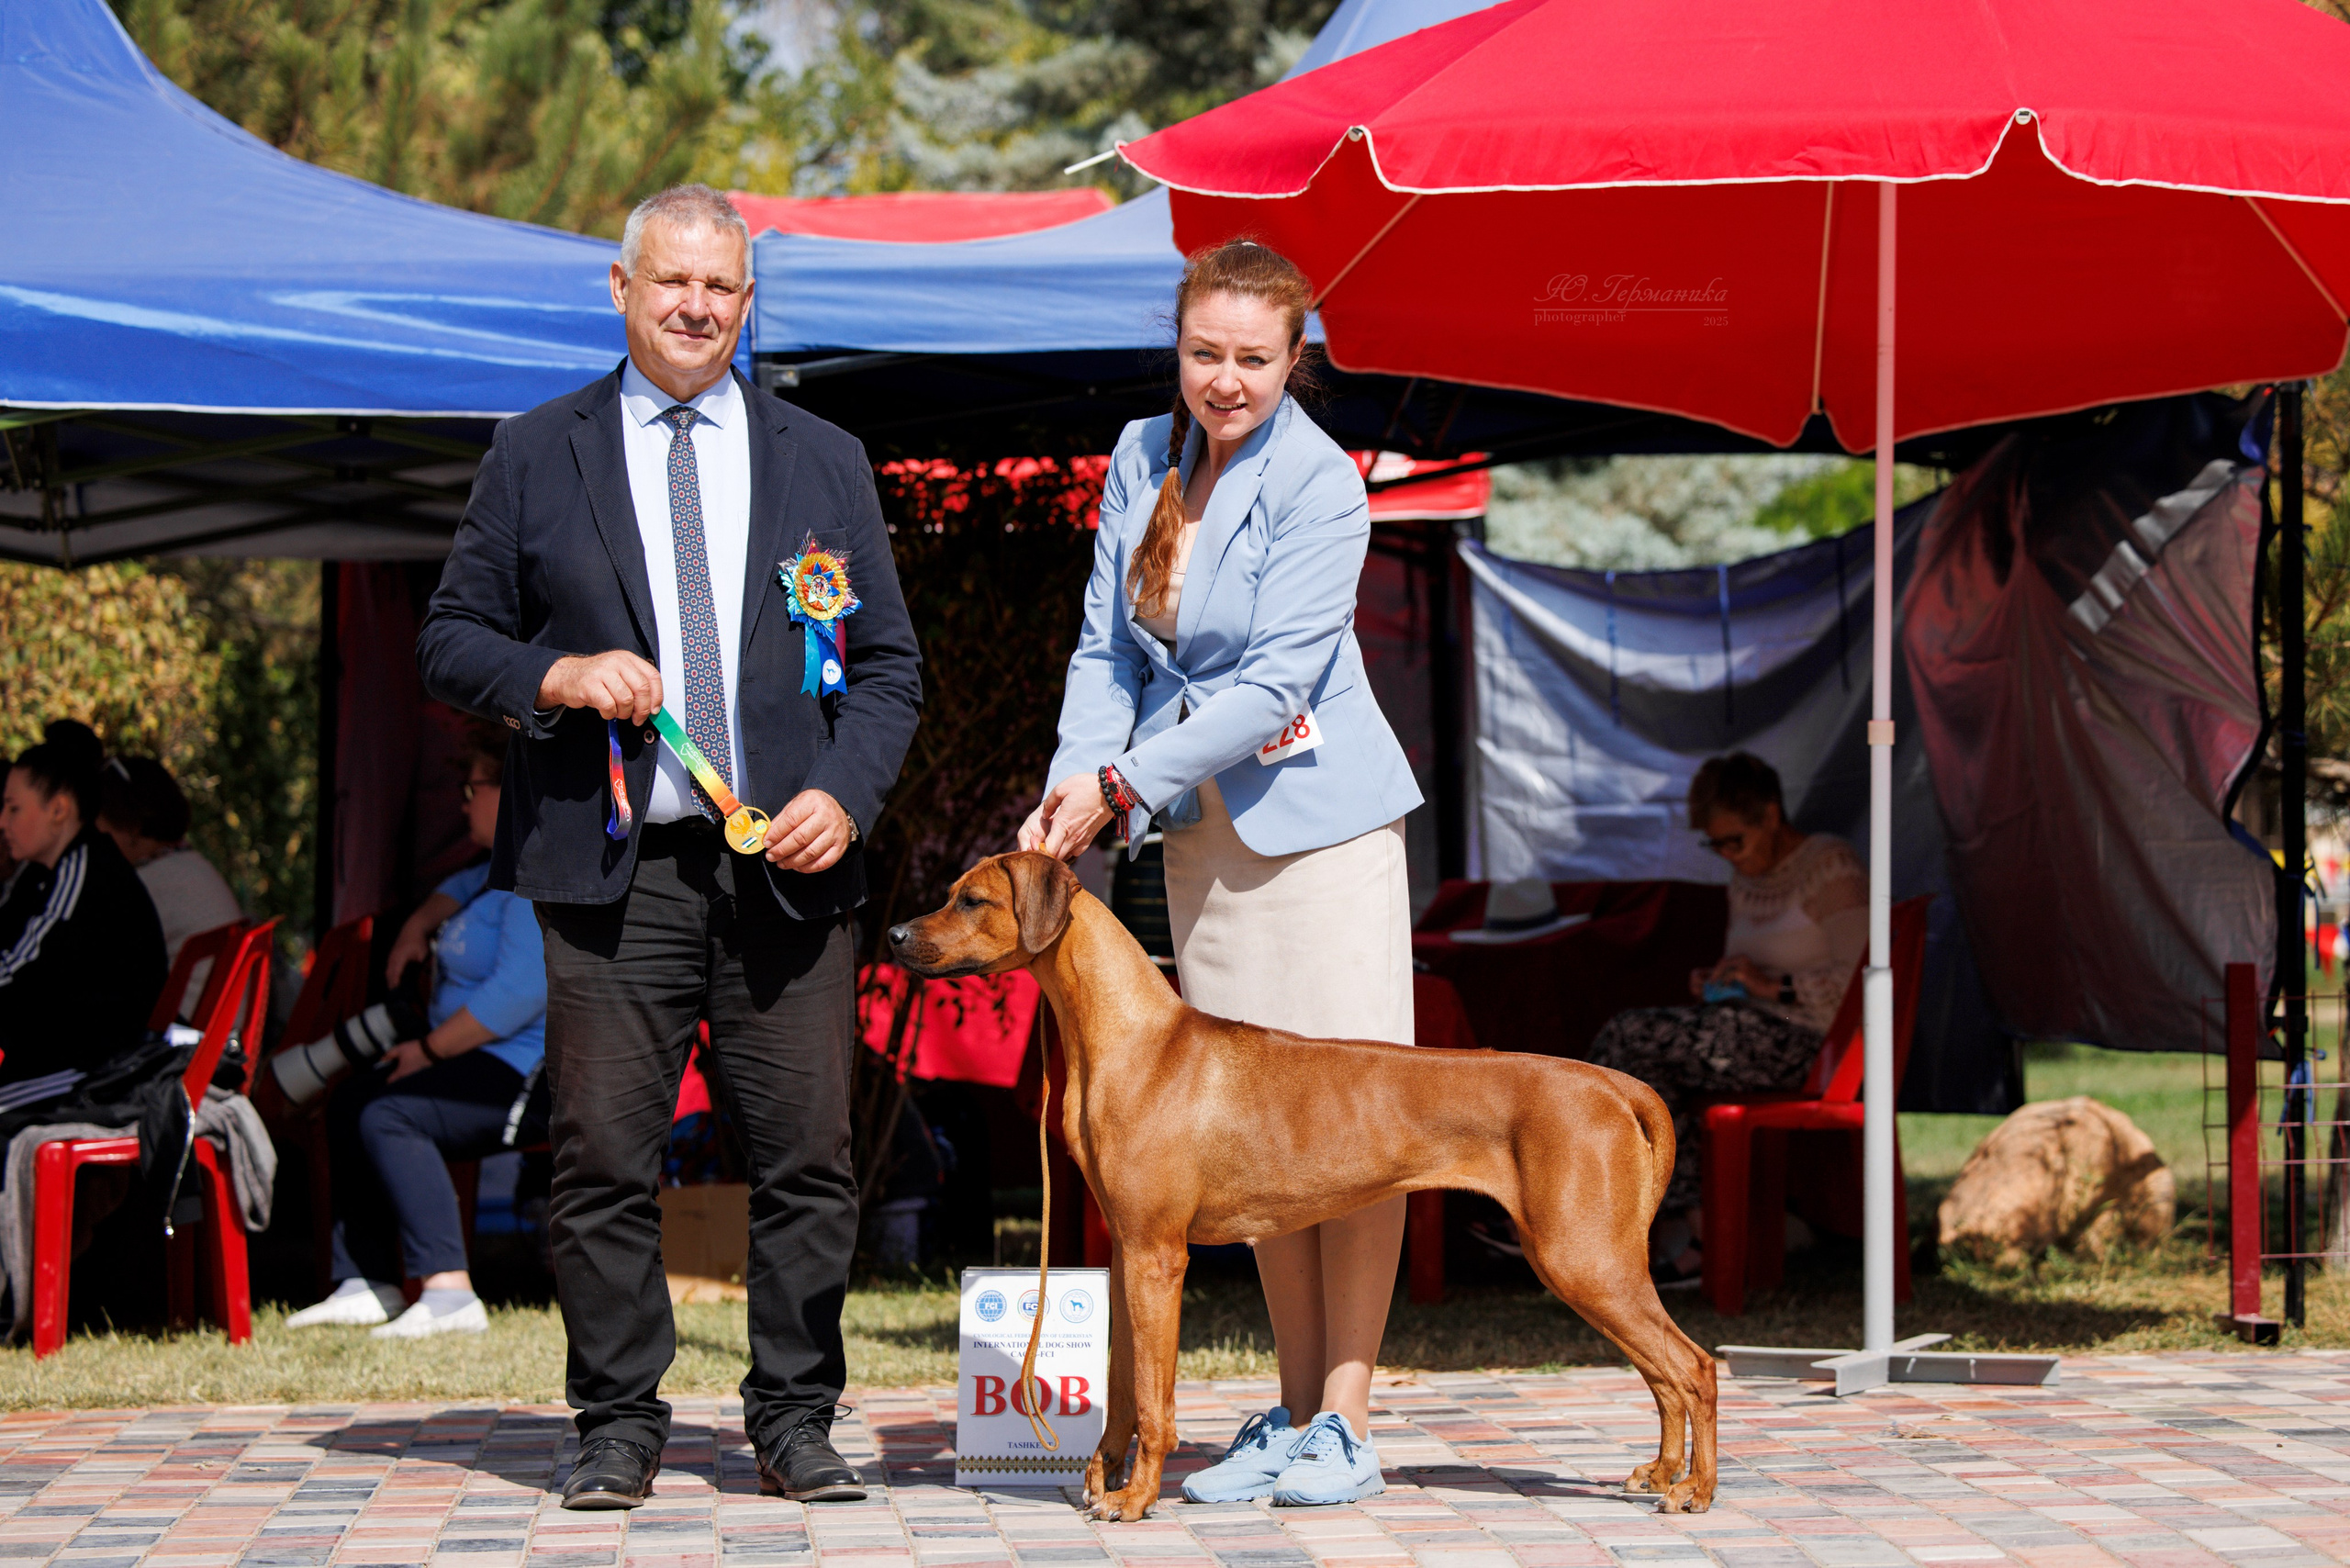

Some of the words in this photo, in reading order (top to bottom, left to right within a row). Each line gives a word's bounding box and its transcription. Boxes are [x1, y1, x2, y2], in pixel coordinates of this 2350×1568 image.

[984, 1302, 999, 1311] FCI
[1024, 1302, 1039, 1311] FC
[970, 1375, 1092, 1417] BOB
